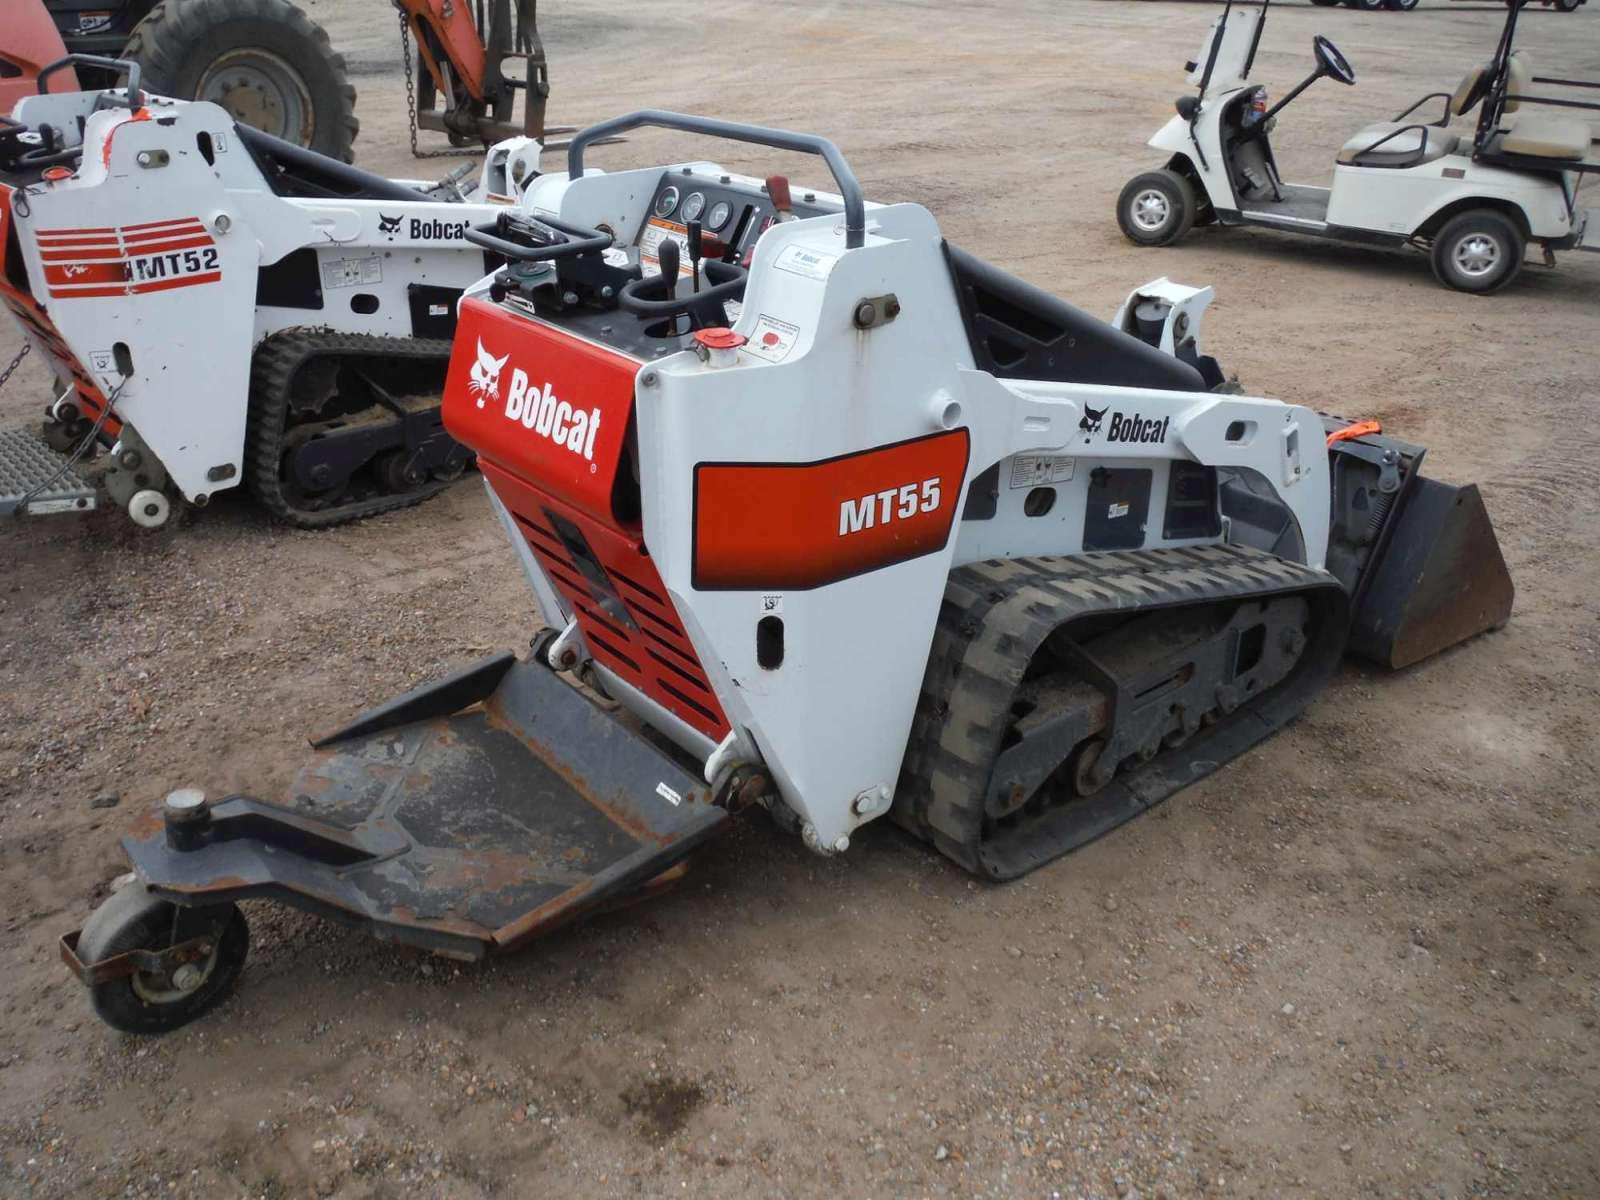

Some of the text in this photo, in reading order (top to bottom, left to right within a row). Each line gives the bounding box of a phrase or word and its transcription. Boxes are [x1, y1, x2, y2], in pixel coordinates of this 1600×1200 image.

[136, 248, 220, 281] MT52
[505, 368, 601, 461] Bobcat
[1106, 411, 1170, 443] Bobcat
[839, 477, 941, 537] MT55
